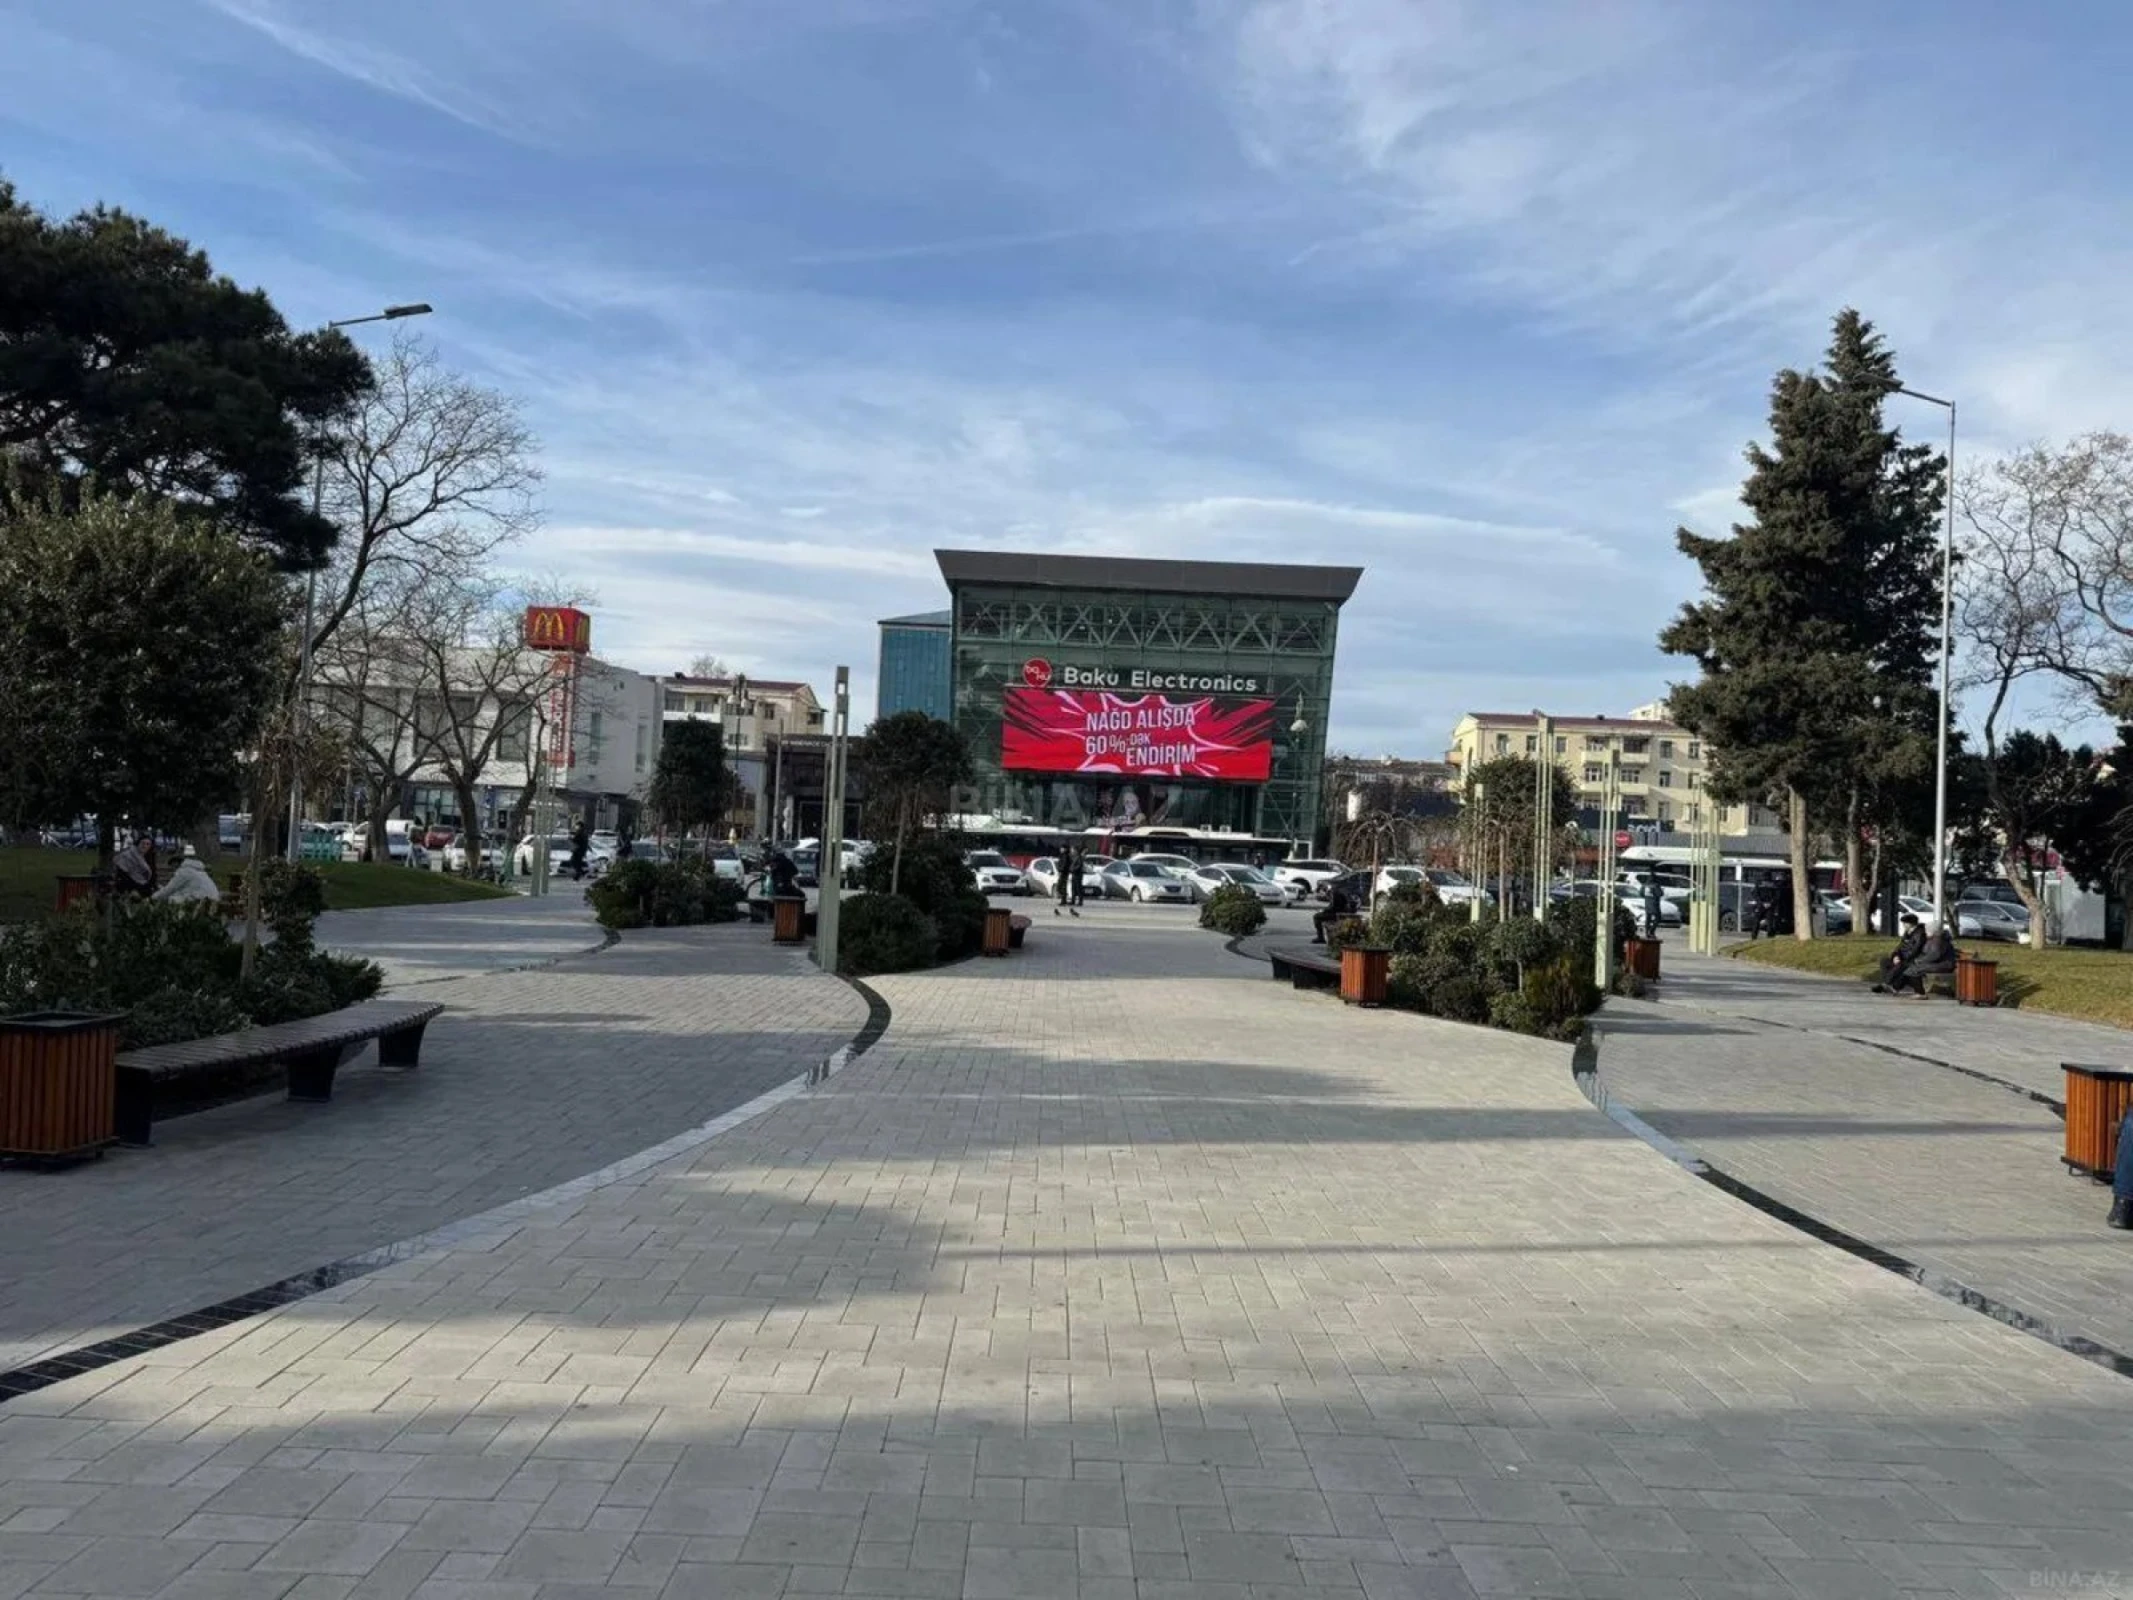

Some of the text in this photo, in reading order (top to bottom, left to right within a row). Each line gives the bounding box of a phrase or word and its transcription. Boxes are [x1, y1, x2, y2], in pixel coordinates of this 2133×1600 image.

[1064, 666, 1257, 691] Baku Electronics
[1136, 706, 1195, 731] ALIŞDA
[1126, 742, 1196, 767] ENDİRİM
